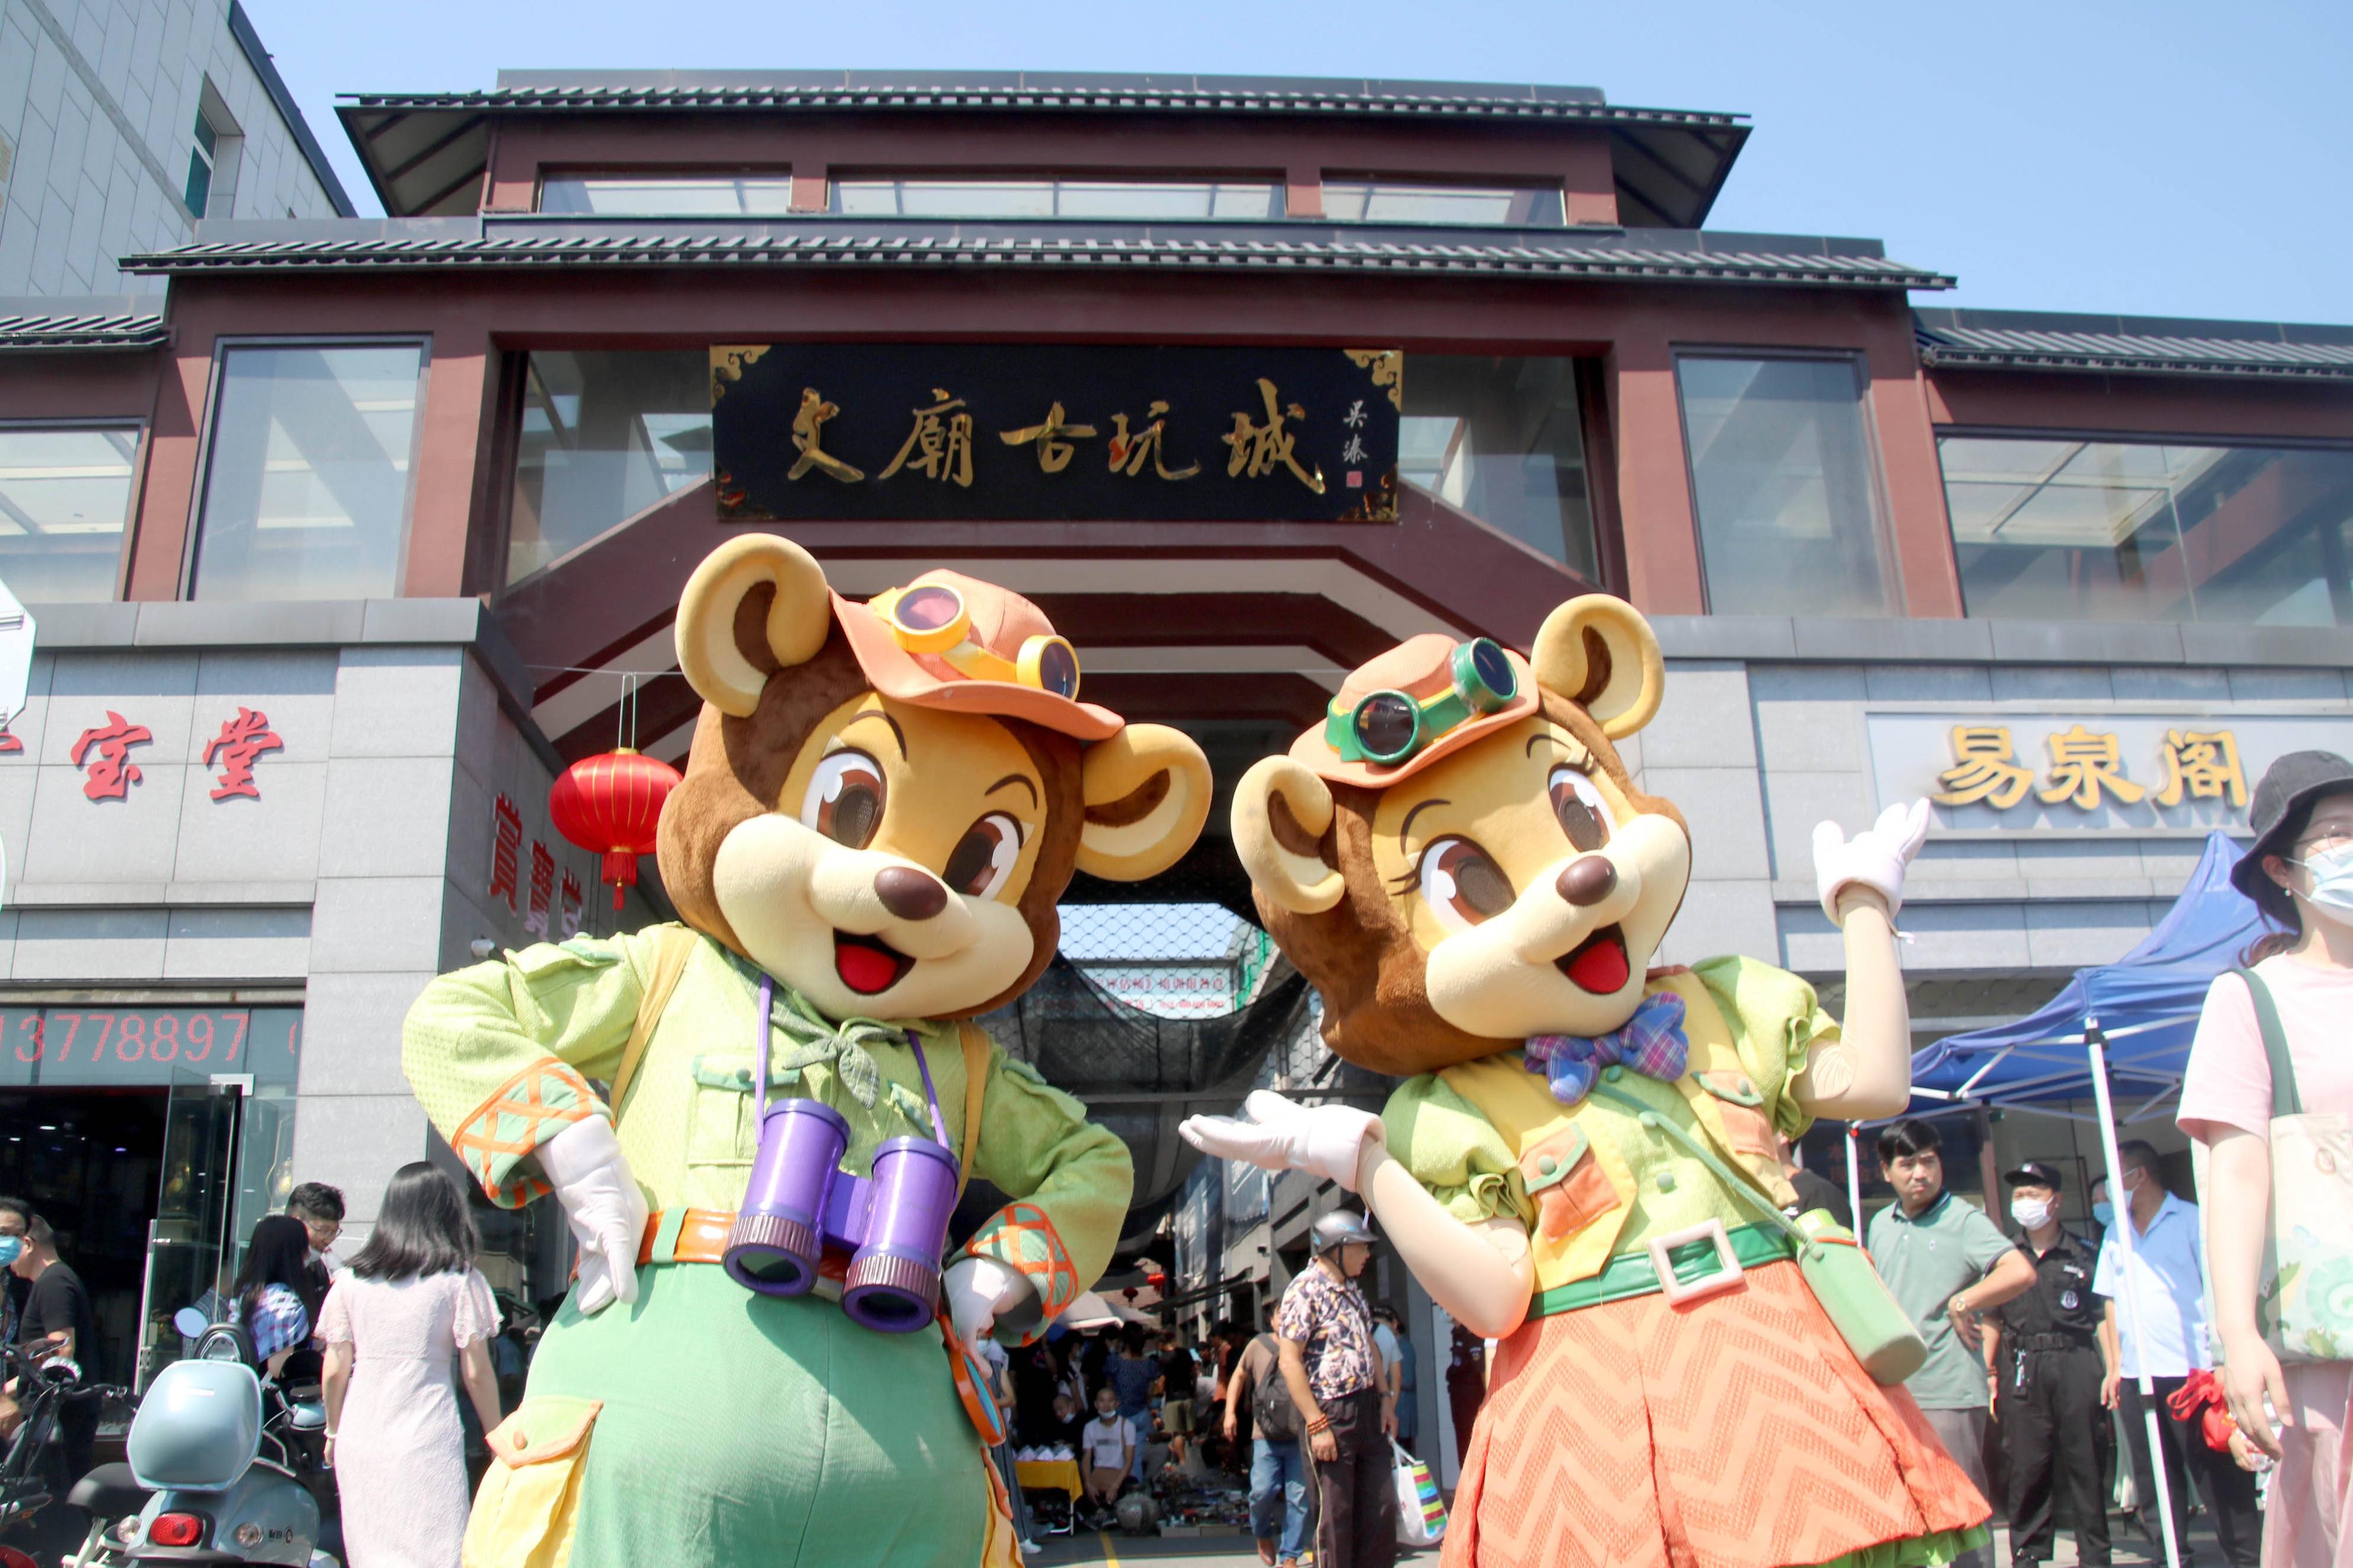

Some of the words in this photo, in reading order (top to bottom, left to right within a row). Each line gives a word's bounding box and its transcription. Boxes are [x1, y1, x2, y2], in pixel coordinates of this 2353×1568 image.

[0, 707, 283, 802] 宝堂
[1932, 724, 2249, 810] 易泉阁
